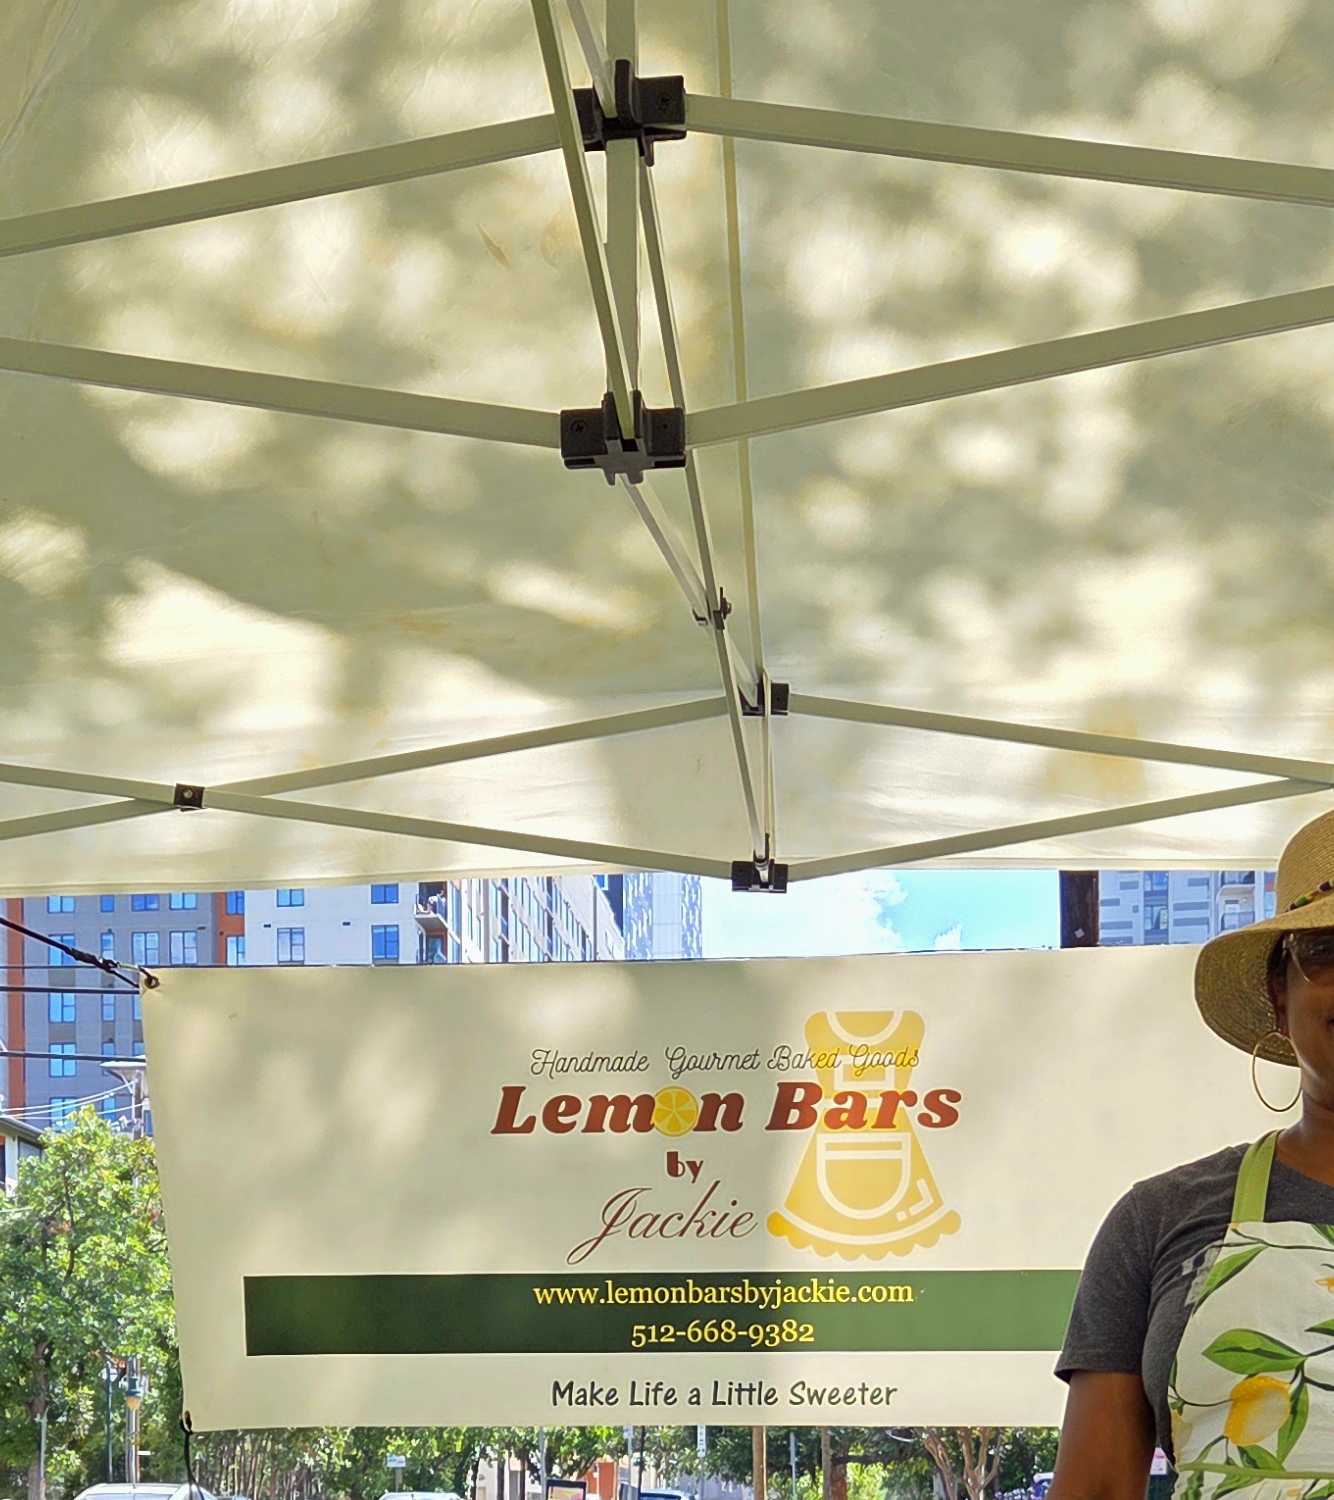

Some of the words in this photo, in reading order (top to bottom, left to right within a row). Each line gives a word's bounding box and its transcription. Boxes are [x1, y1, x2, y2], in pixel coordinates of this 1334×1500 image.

[531, 1048, 650, 1079] Handmade
[665, 1046, 760, 1079] Gourmet
[767, 1045, 842, 1071] Baked
[849, 1044, 920, 1077] Goods
[490, 1085, 745, 1137] Lemon
[765, 1081, 962, 1131] Bars
[666, 1151, 704, 1183] by
[566, 1180, 759, 1265] Jackie
[533, 1278, 914, 1309] www.lemonbarsbyjackie.com
[631, 1319, 814, 1348] 512-668-9382
[552, 1381, 619, 1407] Make
[629, 1380, 678, 1407] Life
[688, 1388, 702, 1406] a
[712, 1380, 779, 1407] Little
[789, 1381, 898, 1407] Sweeter
